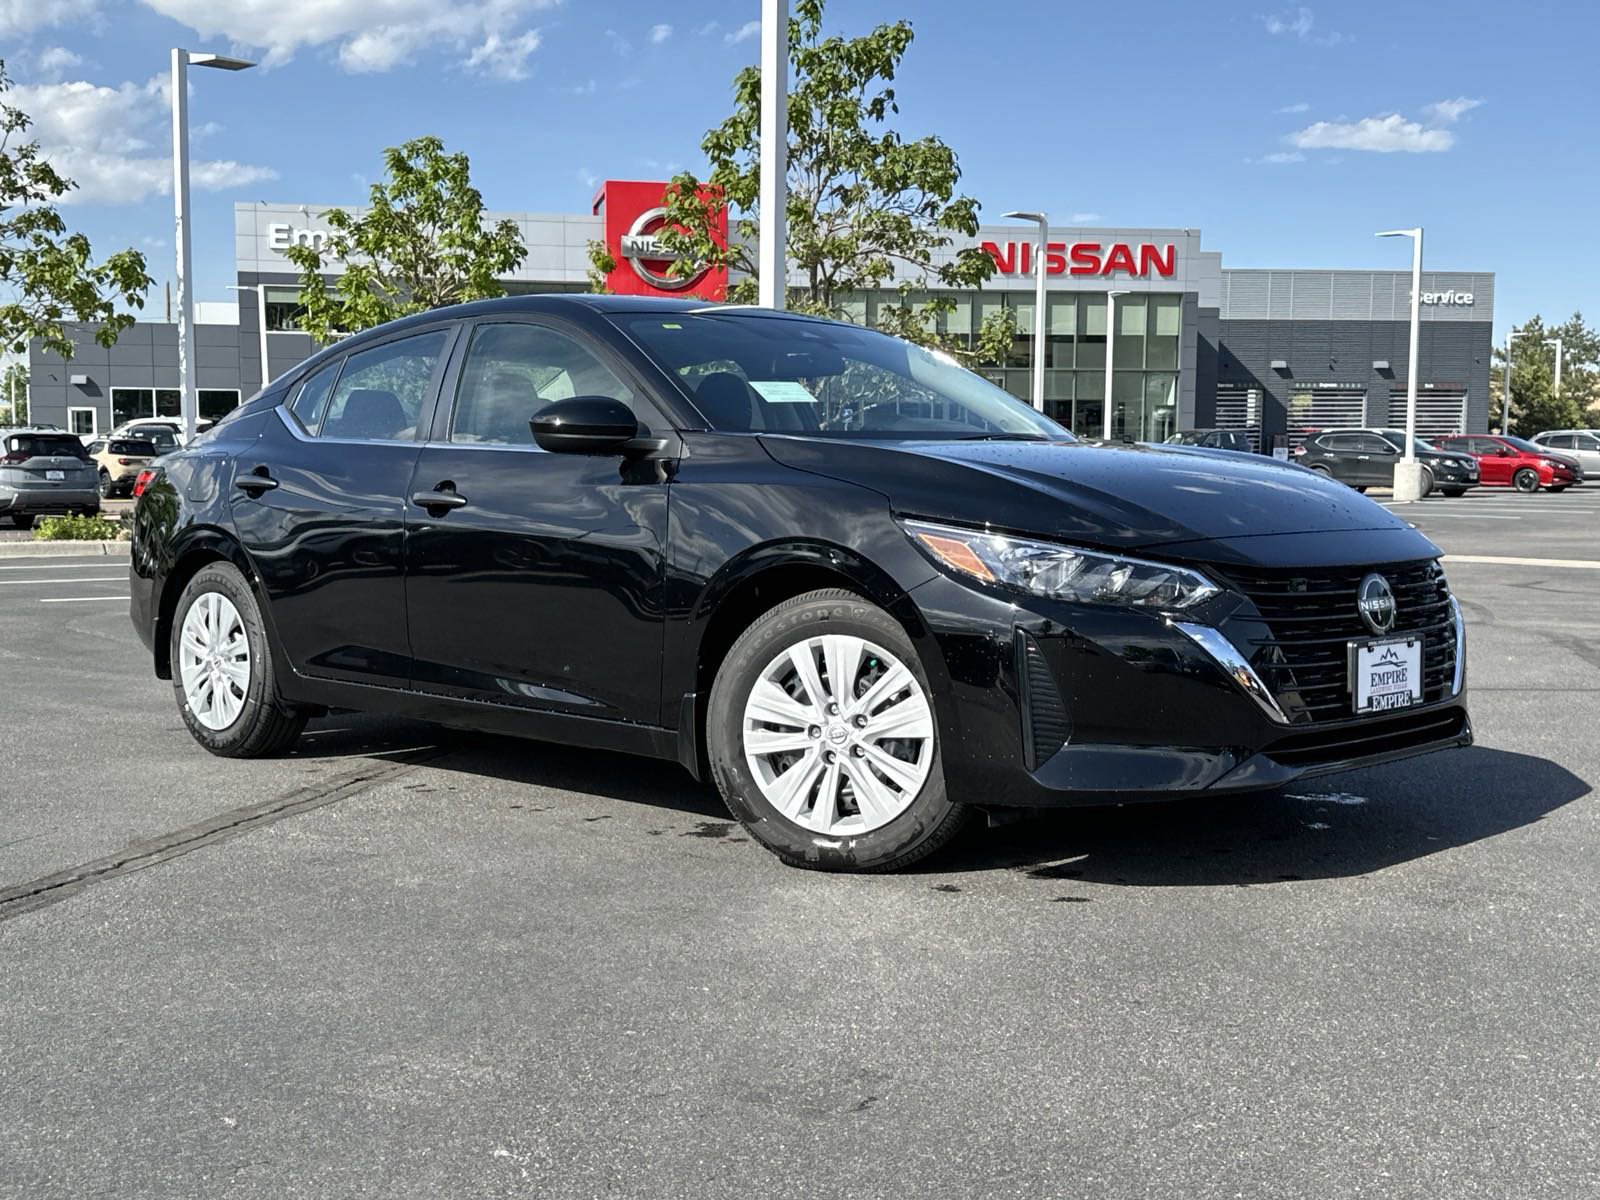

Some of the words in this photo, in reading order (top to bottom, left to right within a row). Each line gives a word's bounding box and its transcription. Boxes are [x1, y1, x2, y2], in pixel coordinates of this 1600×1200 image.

[981, 242, 1175, 276] NISSAN
[1361, 598, 1392, 610] NISSA
[1371, 668, 1408, 688] EMPIRE
[1372, 691, 1411, 711] EMPIRE
